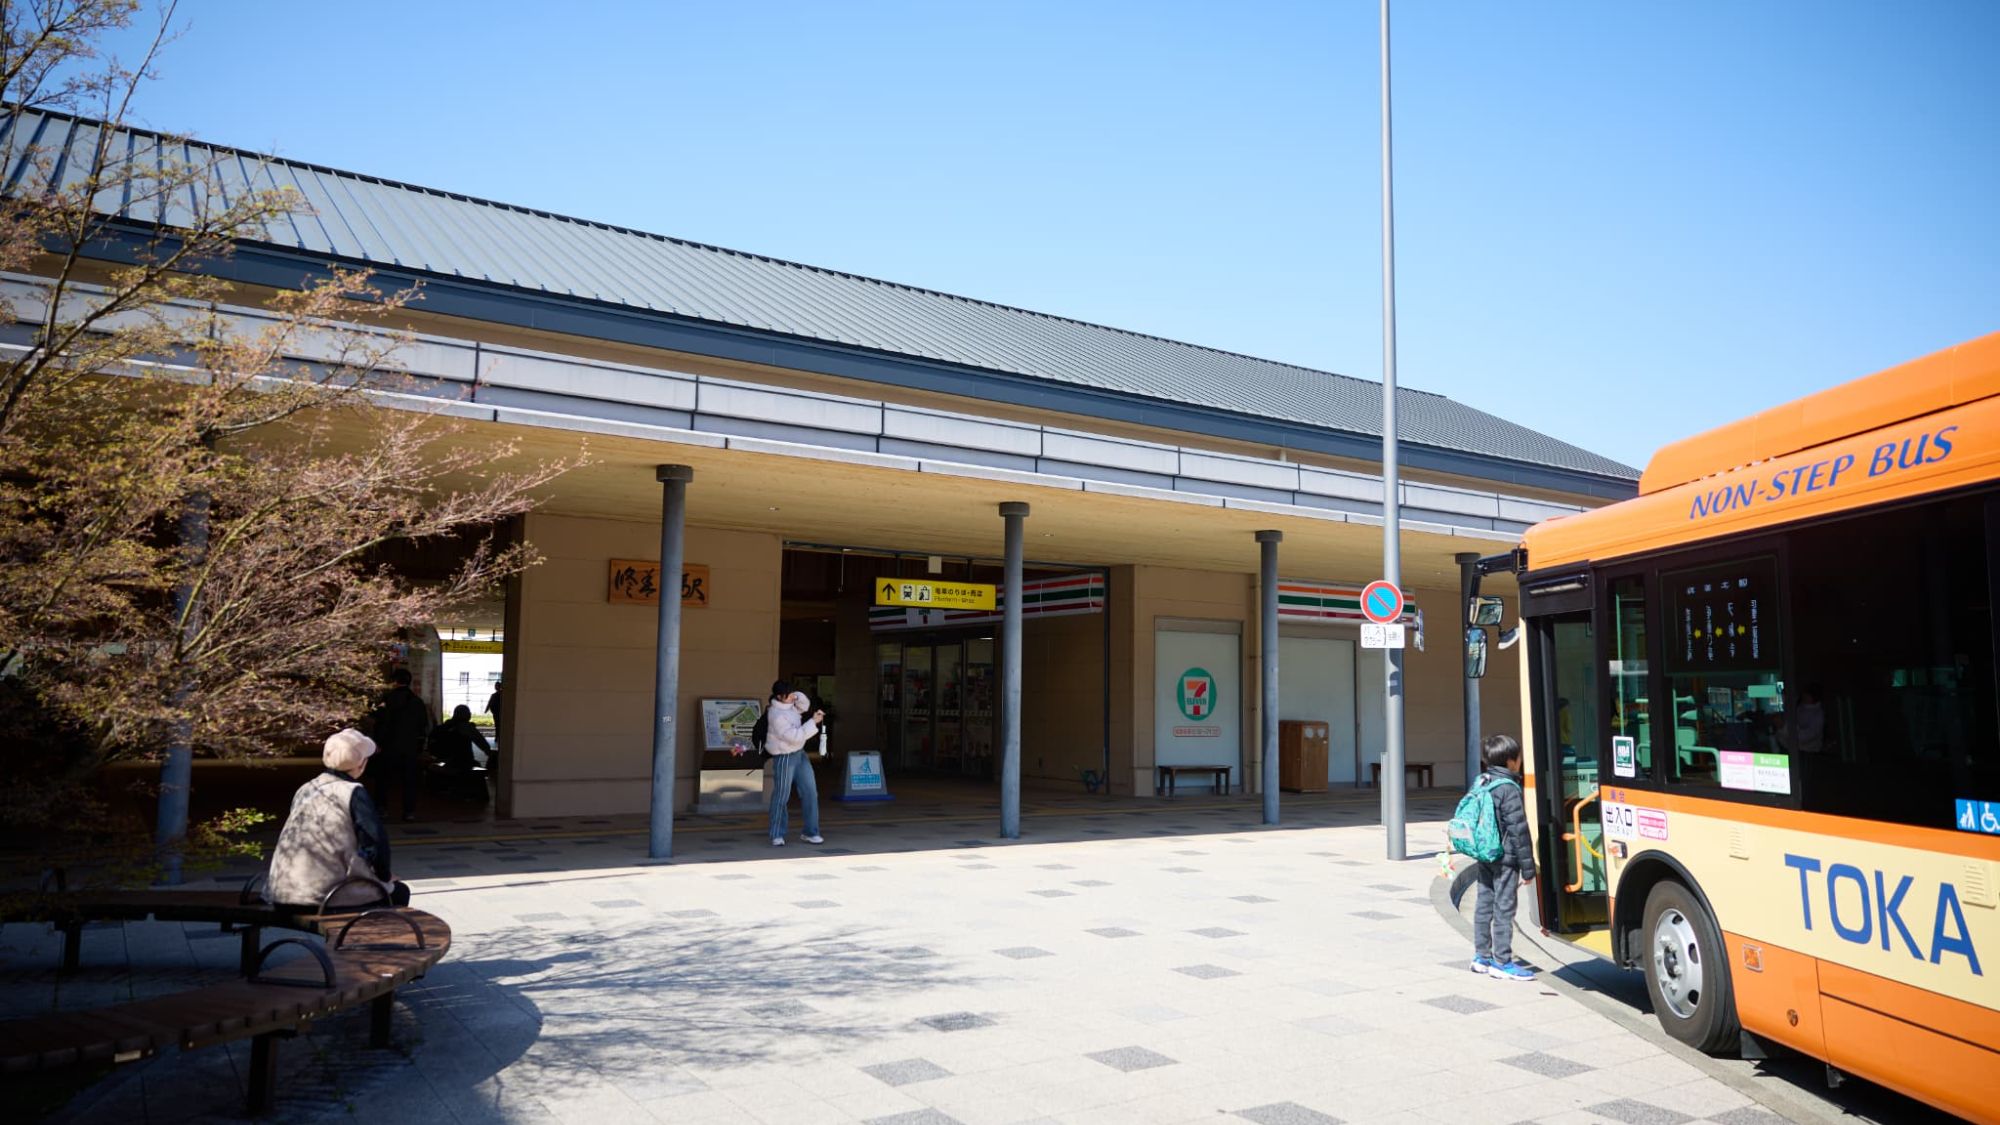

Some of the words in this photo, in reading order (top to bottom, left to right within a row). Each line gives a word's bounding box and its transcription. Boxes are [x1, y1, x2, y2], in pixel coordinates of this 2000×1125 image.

[1689, 454, 1855, 520] NON-STEP
[1868, 426, 1958, 477] BUS
[614, 566, 705, 602] 修善駅
[1186, 680, 1207, 715] 7
[1606, 806, 1632, 827] 出入口
[1784, 853, 1984, 977] TOKA
